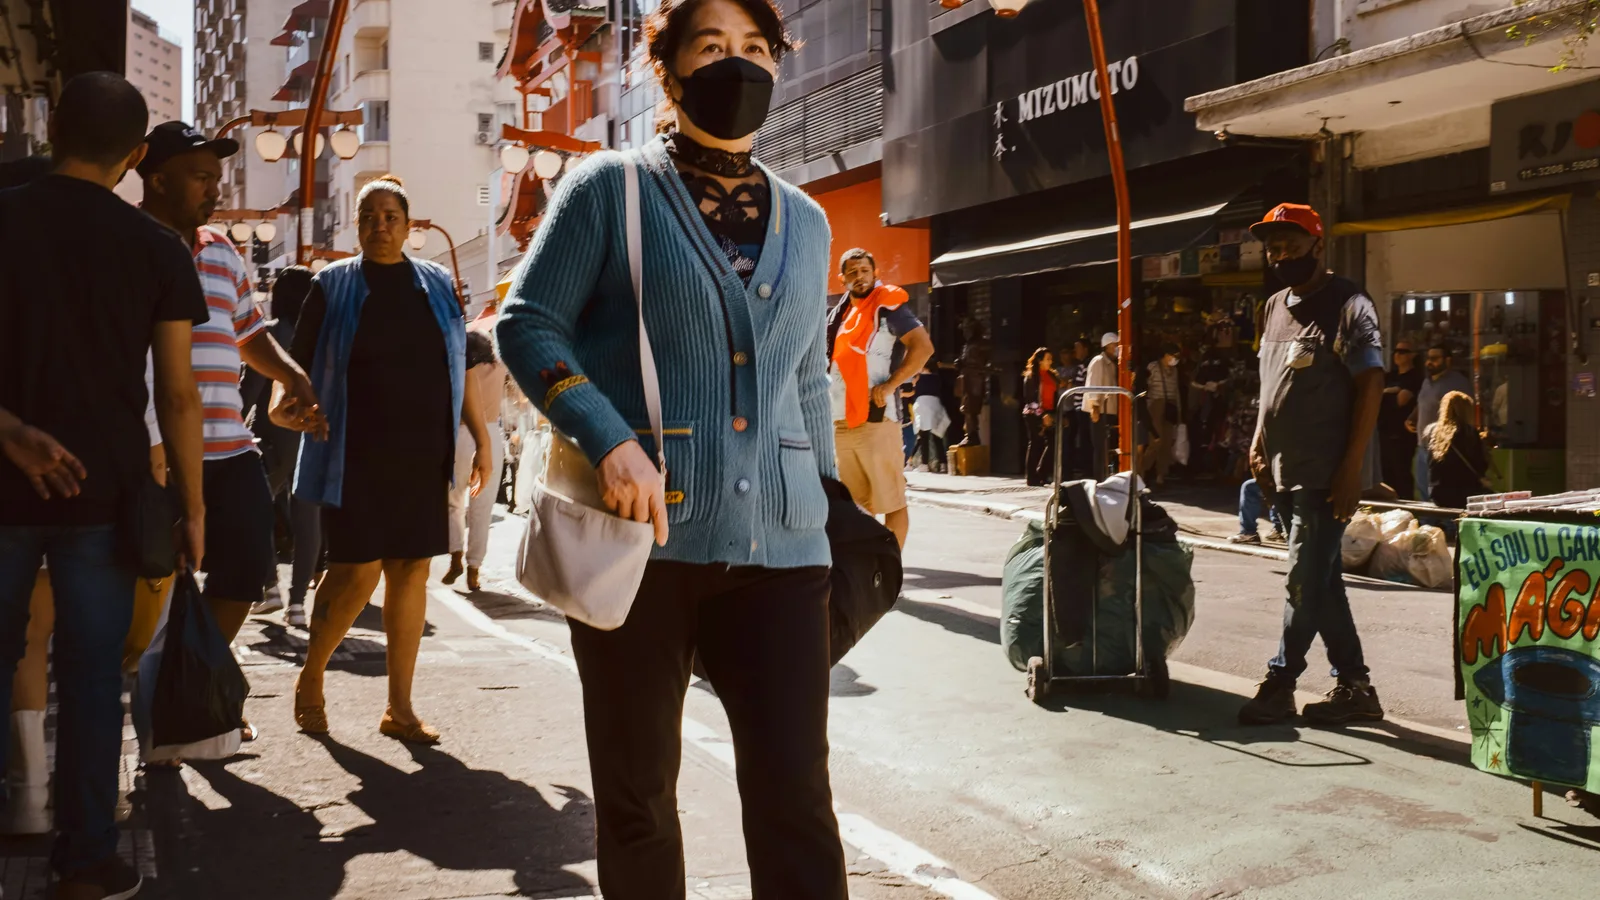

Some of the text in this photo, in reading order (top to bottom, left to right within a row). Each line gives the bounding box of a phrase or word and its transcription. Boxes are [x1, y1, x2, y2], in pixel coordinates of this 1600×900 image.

[1018, 55, 1139, 123] MIZUMOTO
[1463, 548, 1490, 591] EU
[1490, 529, 1530, 571] SOU
[1533, 527, 1549, 562] O
